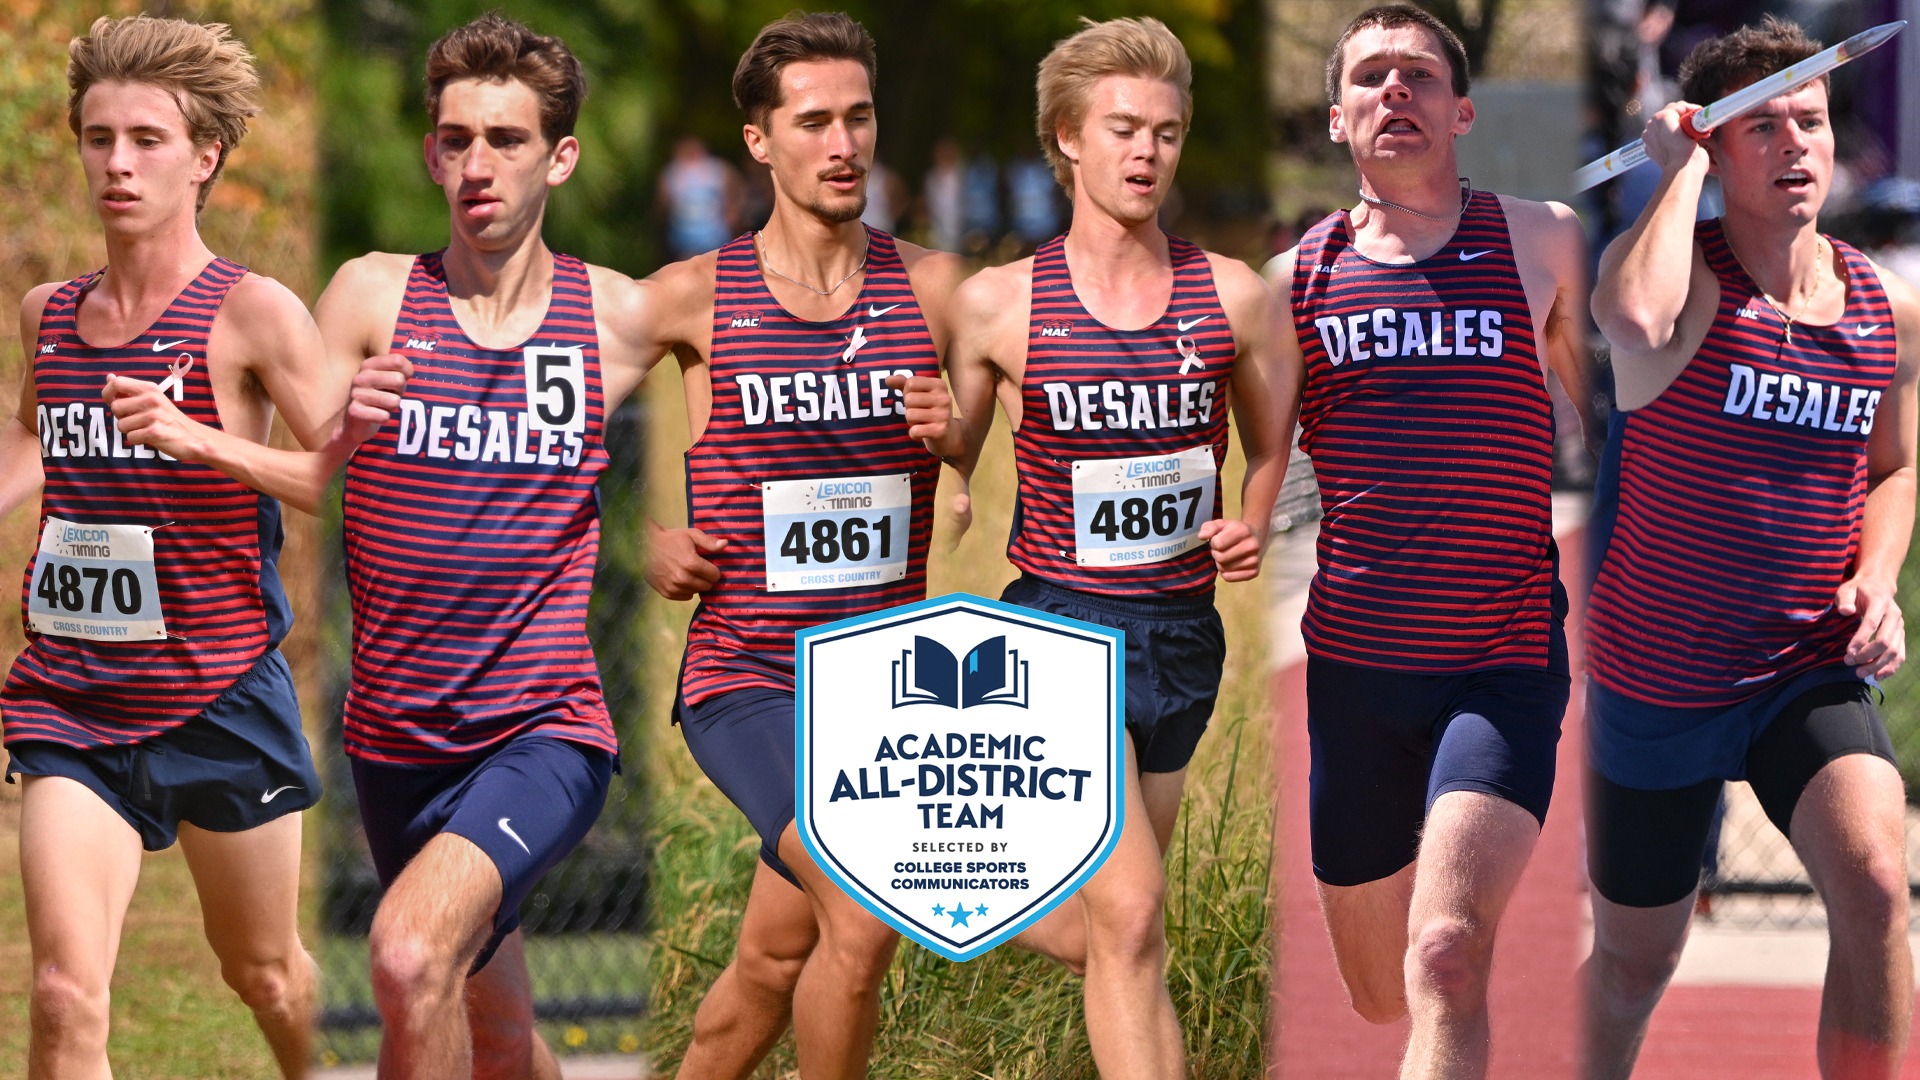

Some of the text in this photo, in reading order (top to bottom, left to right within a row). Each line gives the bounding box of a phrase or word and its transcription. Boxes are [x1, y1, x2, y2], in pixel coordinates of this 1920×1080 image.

[1312, 264, 1340, 275] MAC
[731, 318, 760, 328] MAC
[1735, 308, 1759, 320] MAC
[1041, 327, 1070, 338] MAC
[1315, 308, 1503, 367] DESALES
[41, 344, 57, 354] MAC
[405, 338, 437, 351] MAC
[536, 354, 576, 426] 5
[1723, 363, 1882, 435] DESALES
[1043, 381, 1216, 431] DESALES
[37, 403, 178, 461] DESAL
[1126, 457, 1180, 478] LEXICON
[1135, 472, 1181, 488] TIMING
[816, 481, 872, 500] LEXICON
[825, 495, 873, 510] TIMING
[1090, 486, 1203, 542] 4867
[62, 525, 110, 543] LEXICON
[780, 515, 892, 565] 4861
[68, 543, 111, 558] TIMING
[1109, 541, 1188, 562] CROSS COUNTRY
[800, 570, 881, 585] CROSS COUNTRY
[37, 562, 142, 615] 4870
[53, 621, 128, 636] CROSS COUNTRY
